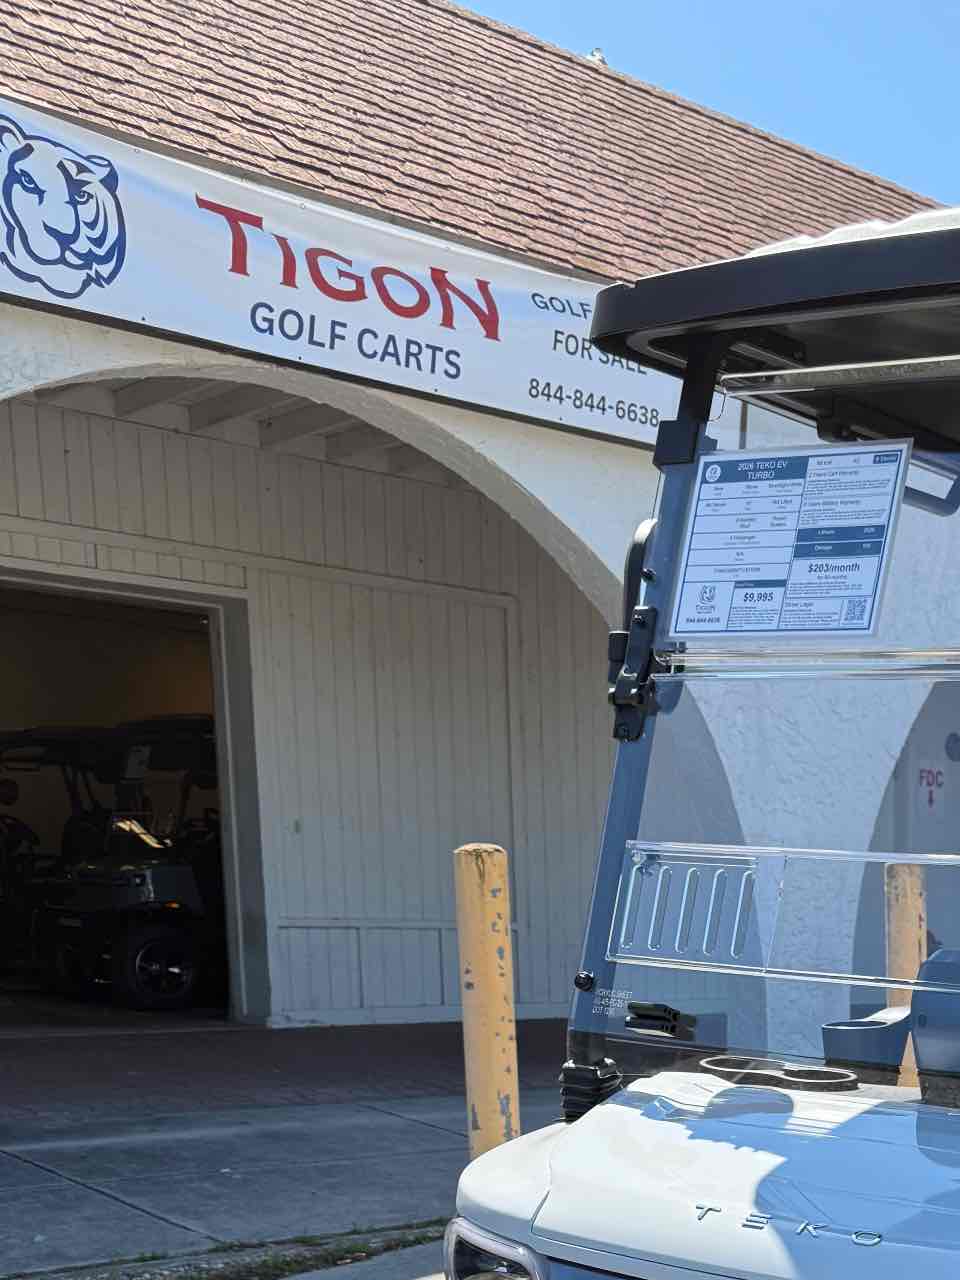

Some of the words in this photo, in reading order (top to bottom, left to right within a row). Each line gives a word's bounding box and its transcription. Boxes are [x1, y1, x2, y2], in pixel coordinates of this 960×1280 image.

[195, 191, 501, 342] TIGON
[531, 293, 593, 320] GOLF
[249, 301, 348, 350] GOLF
[356, 328, 461, 380] CARTS
[552, 330, 593, 361] FOR
[528, 378, 660, 428] 844-844-6638
[747, 470, 775, 480] TURBO
[919, 770, 944, 788] FDC
[696, 1204, 882, 1246] TEKO
